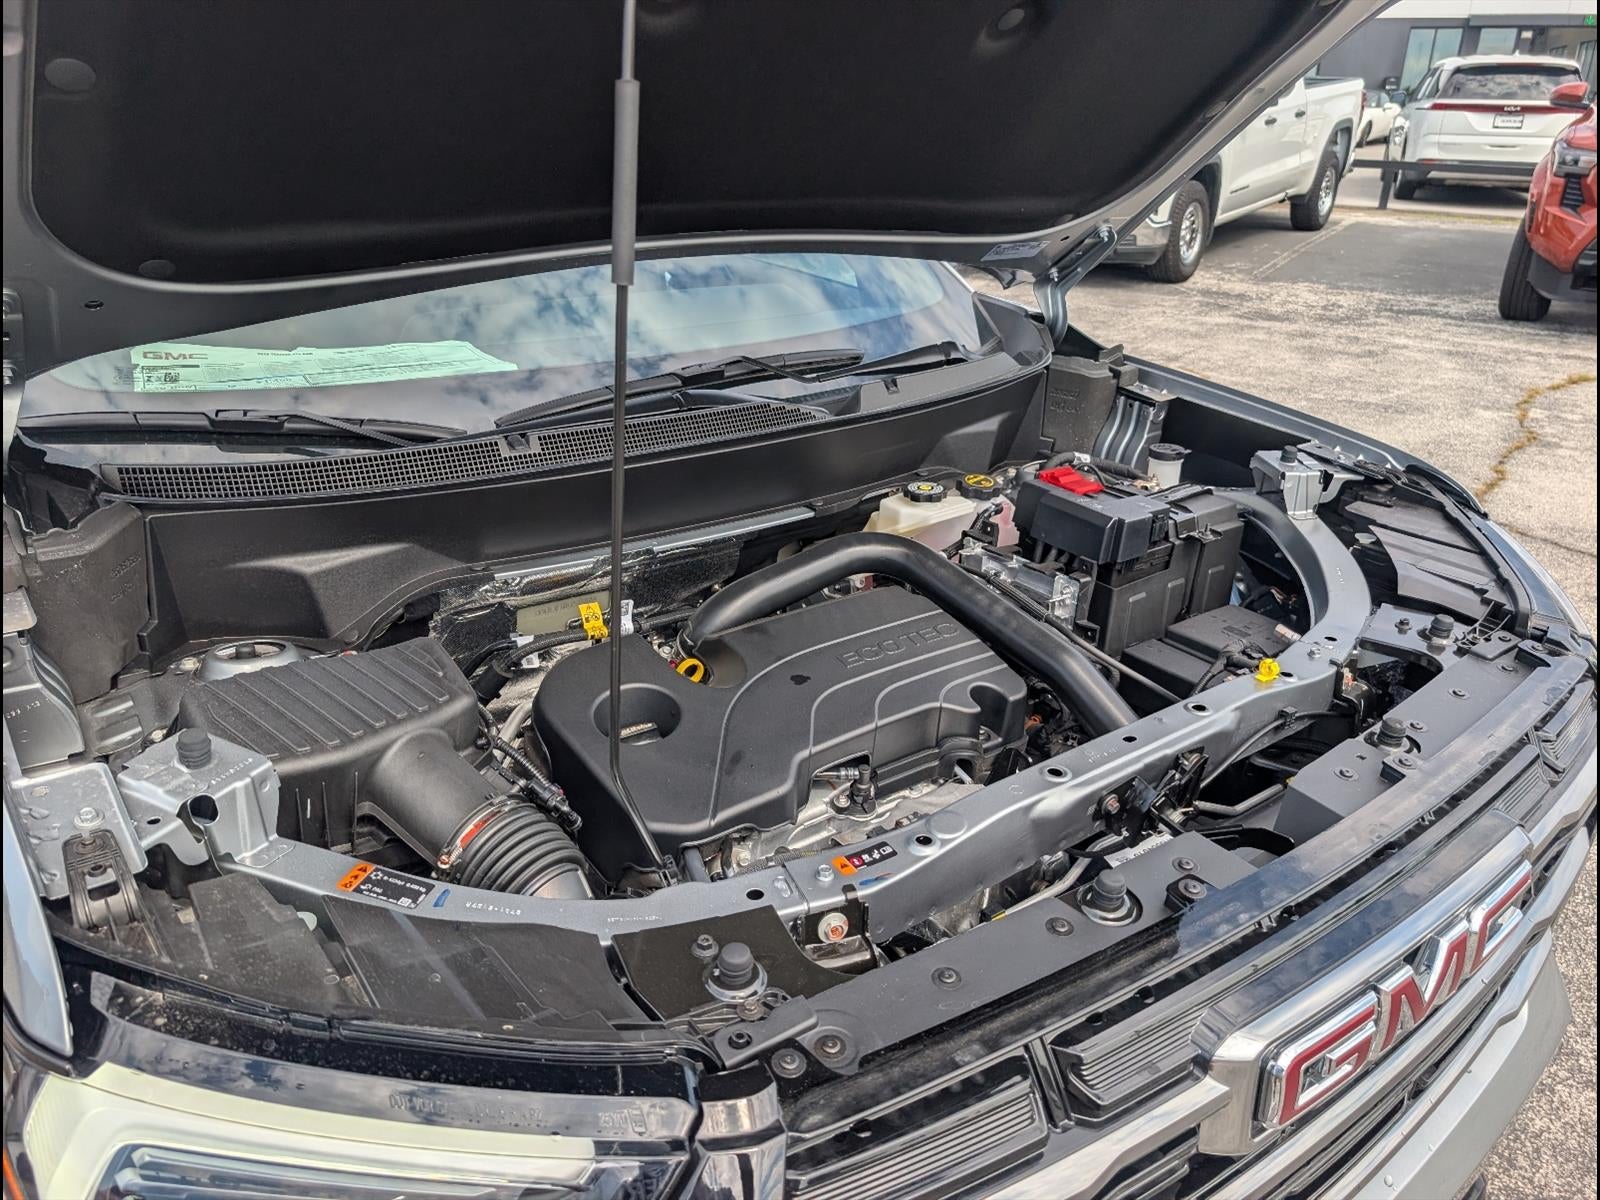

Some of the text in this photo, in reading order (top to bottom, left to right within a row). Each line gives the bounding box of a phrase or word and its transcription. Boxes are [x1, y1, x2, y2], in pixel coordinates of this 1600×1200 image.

[142, 351, 209, 360] GMC
[836, 623, 960, 668] ECOTEC
[1268, 859, 1532, 1126] GMC
